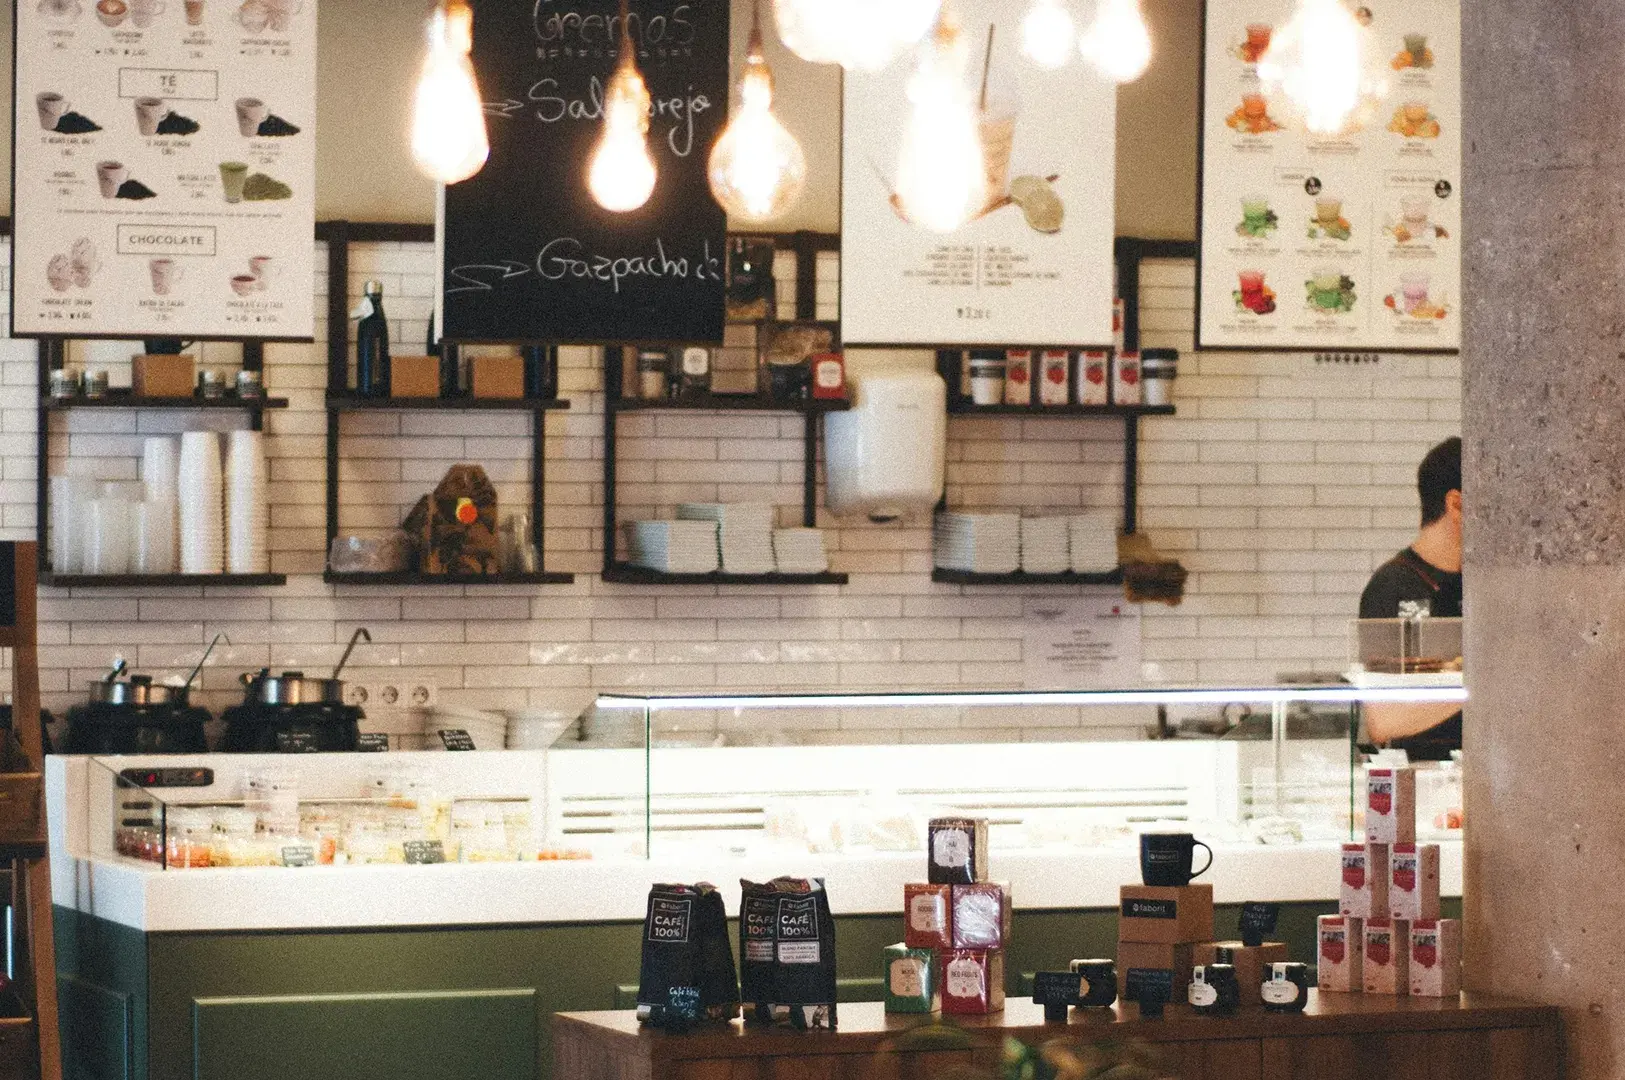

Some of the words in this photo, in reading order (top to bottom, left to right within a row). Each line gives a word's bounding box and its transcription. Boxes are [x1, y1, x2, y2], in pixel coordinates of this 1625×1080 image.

[160, 73, 177, 86] TÉ
[528, 75, 711, 157] Salrejo
[129, 234, 204, 245] CHOCOLATE
[536, 237, 688, 293] Gazpacho
[1140, 902, 1166, 912] faborit
[655, 914, 682, 926] CAFÉ
[781, 912, 809, 924] CAFÉ
[655, 927, 680, 937] 100%
[747, 925, 774, 935] 100%
[782, 926, 811, 936] 100%
